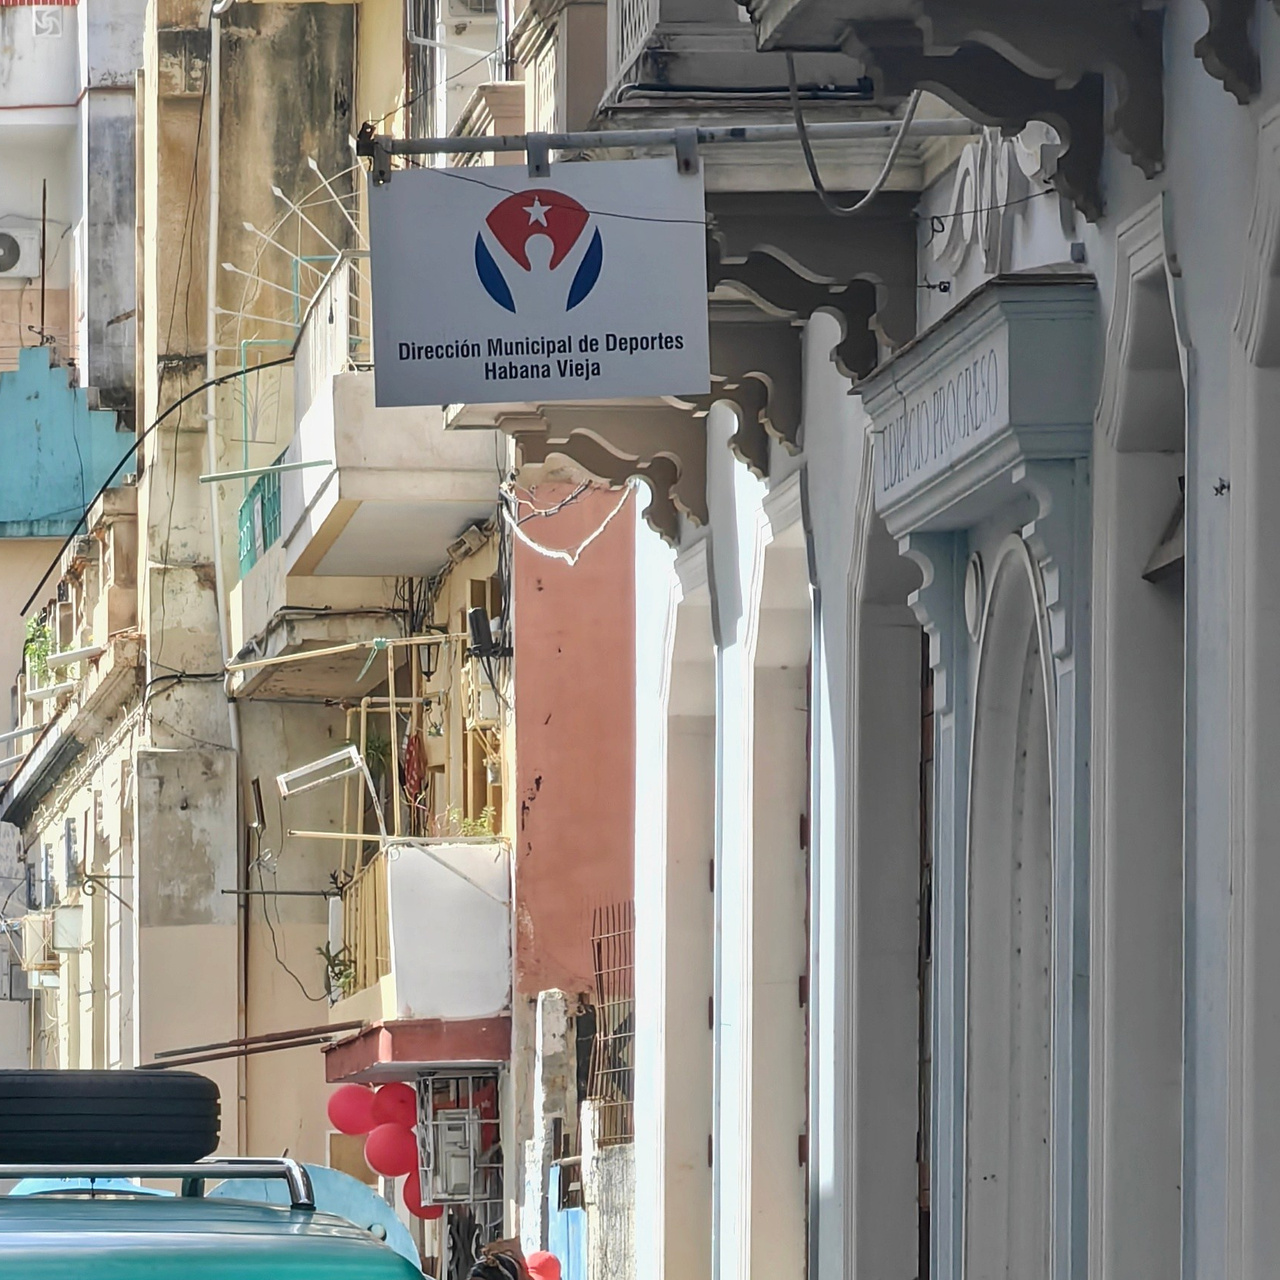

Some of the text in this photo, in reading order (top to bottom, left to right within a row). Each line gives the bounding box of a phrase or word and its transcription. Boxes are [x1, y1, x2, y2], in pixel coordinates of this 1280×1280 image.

[398, 332, 684, 361] Dirección Municipal de Deportes
[484, 359, 601, 381] Habana Vieja
[933, 349, 999, 459] PROGRESO
